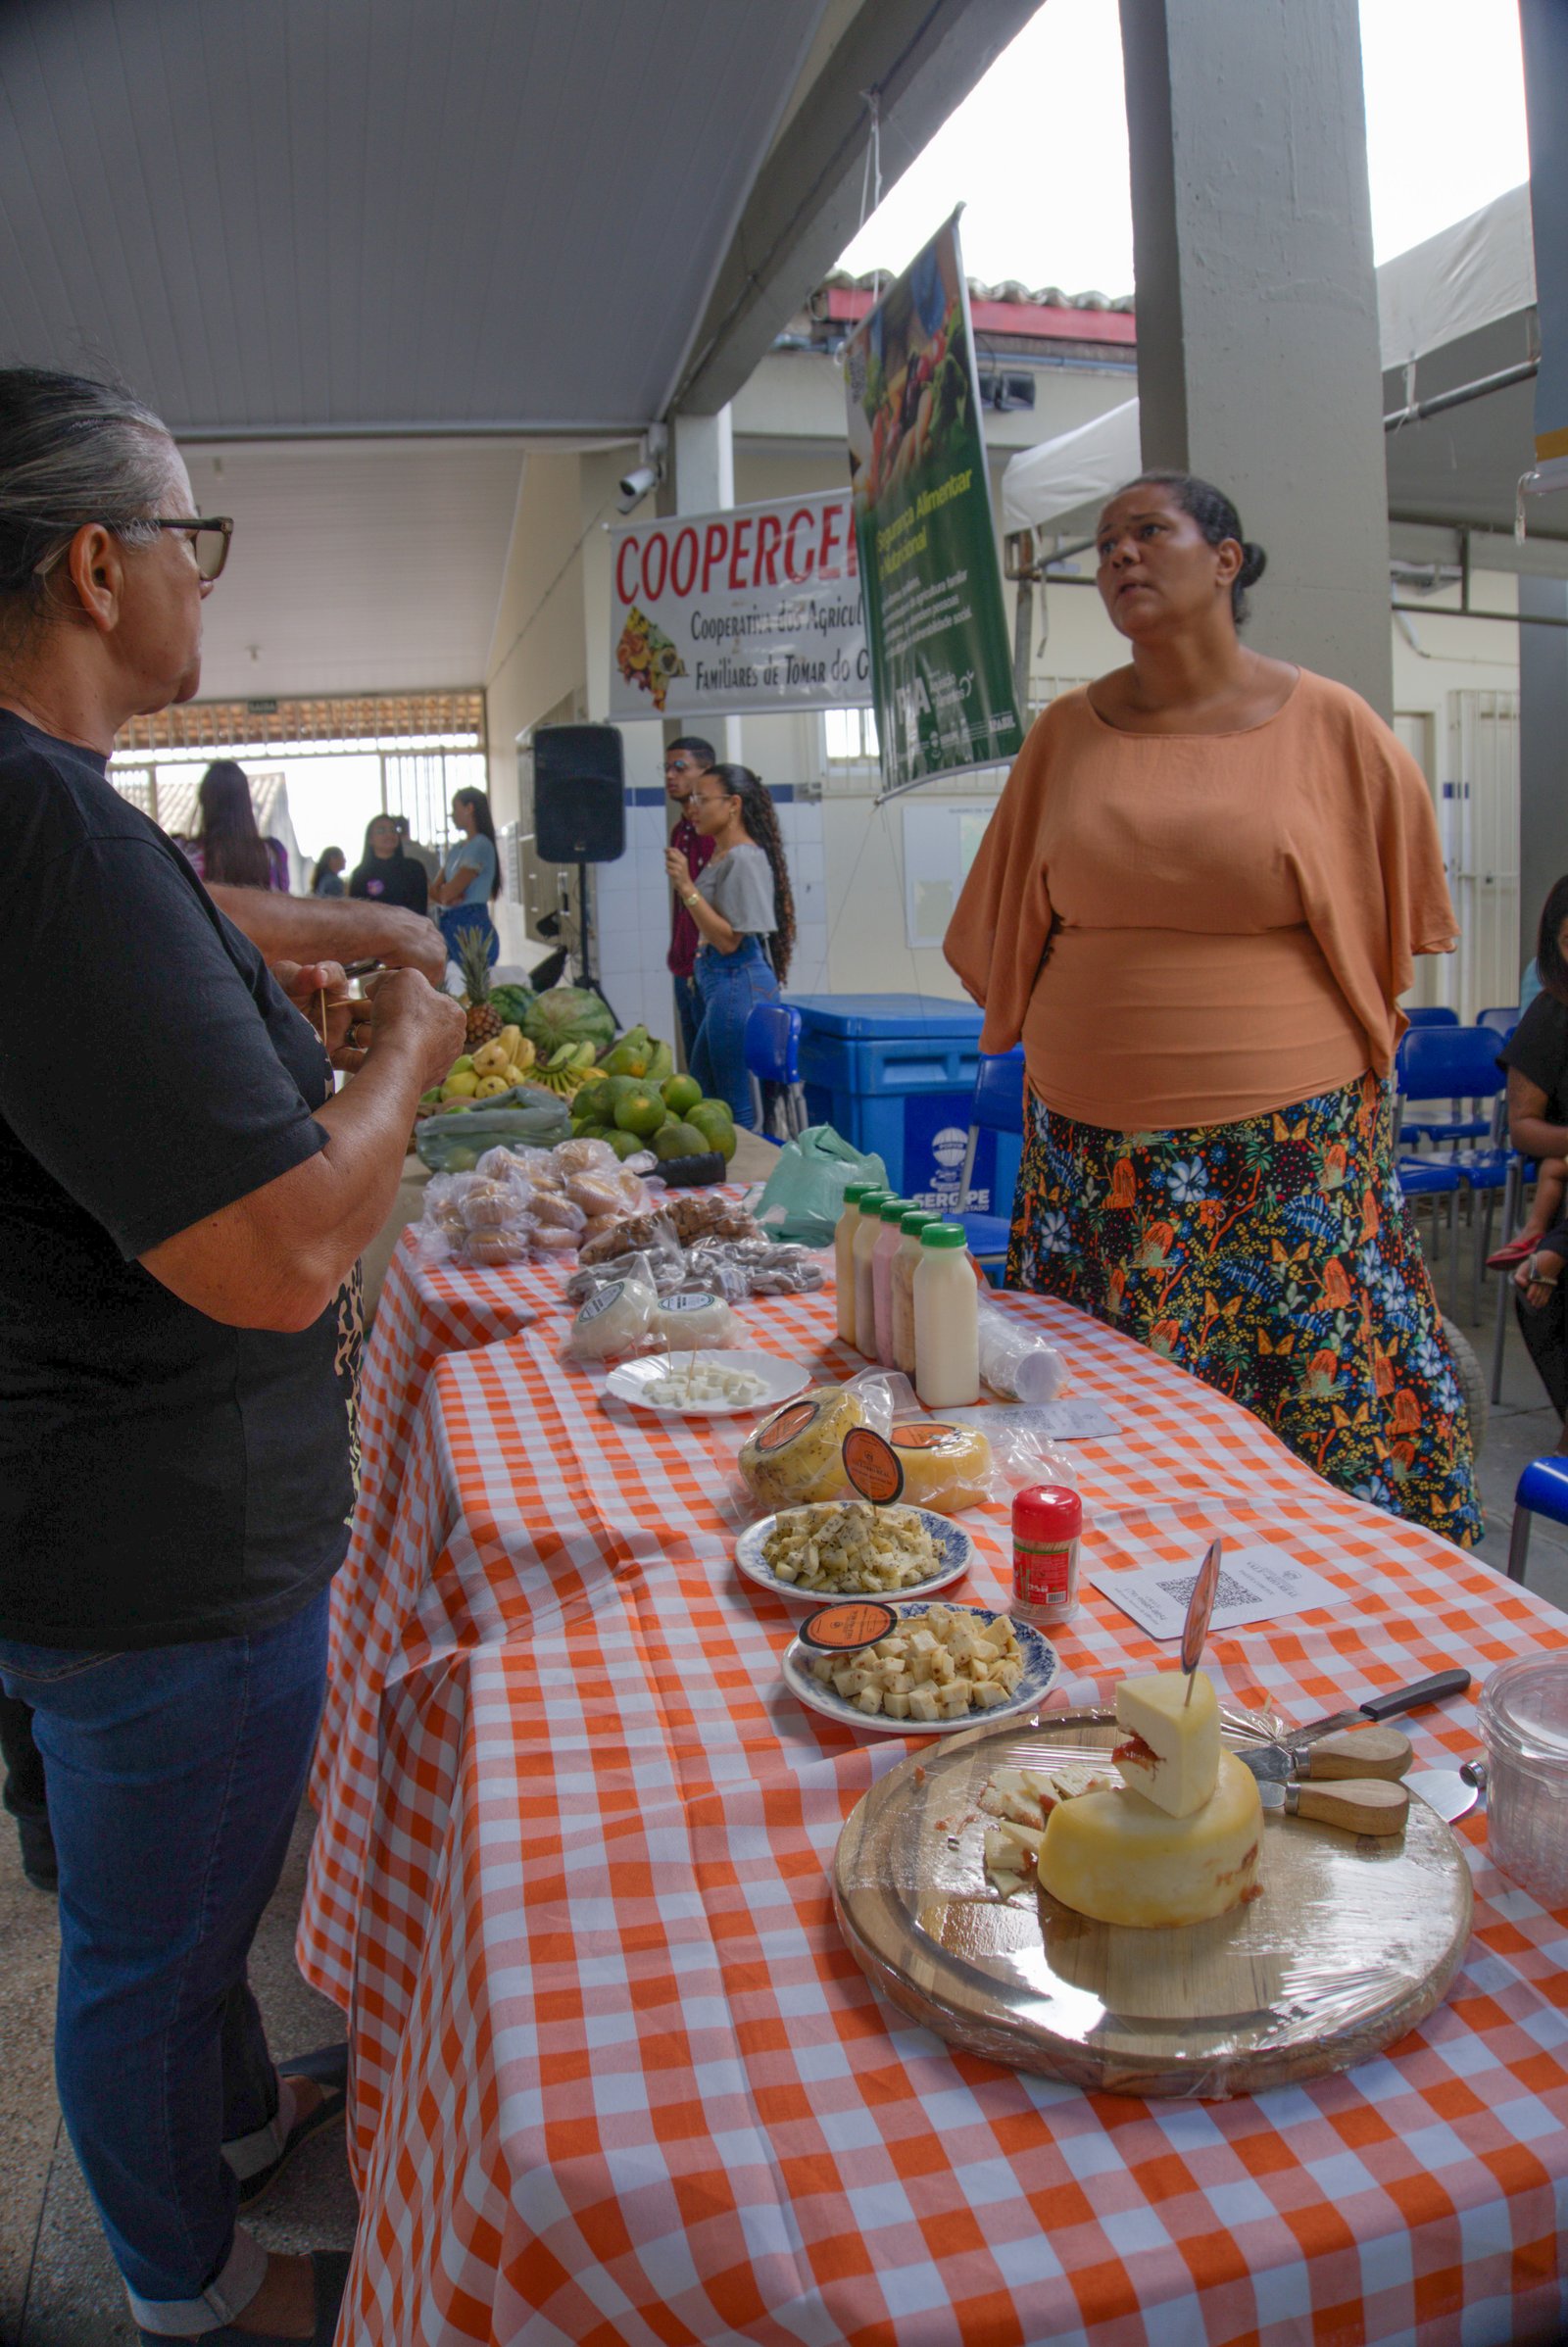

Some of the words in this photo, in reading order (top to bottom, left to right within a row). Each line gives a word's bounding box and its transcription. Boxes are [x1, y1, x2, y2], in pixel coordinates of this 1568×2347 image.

[916, 468, 972, 519] Alimentar
[832, 648, 851, 682] do
[912, 1189, 990, 1208] SERGPE
